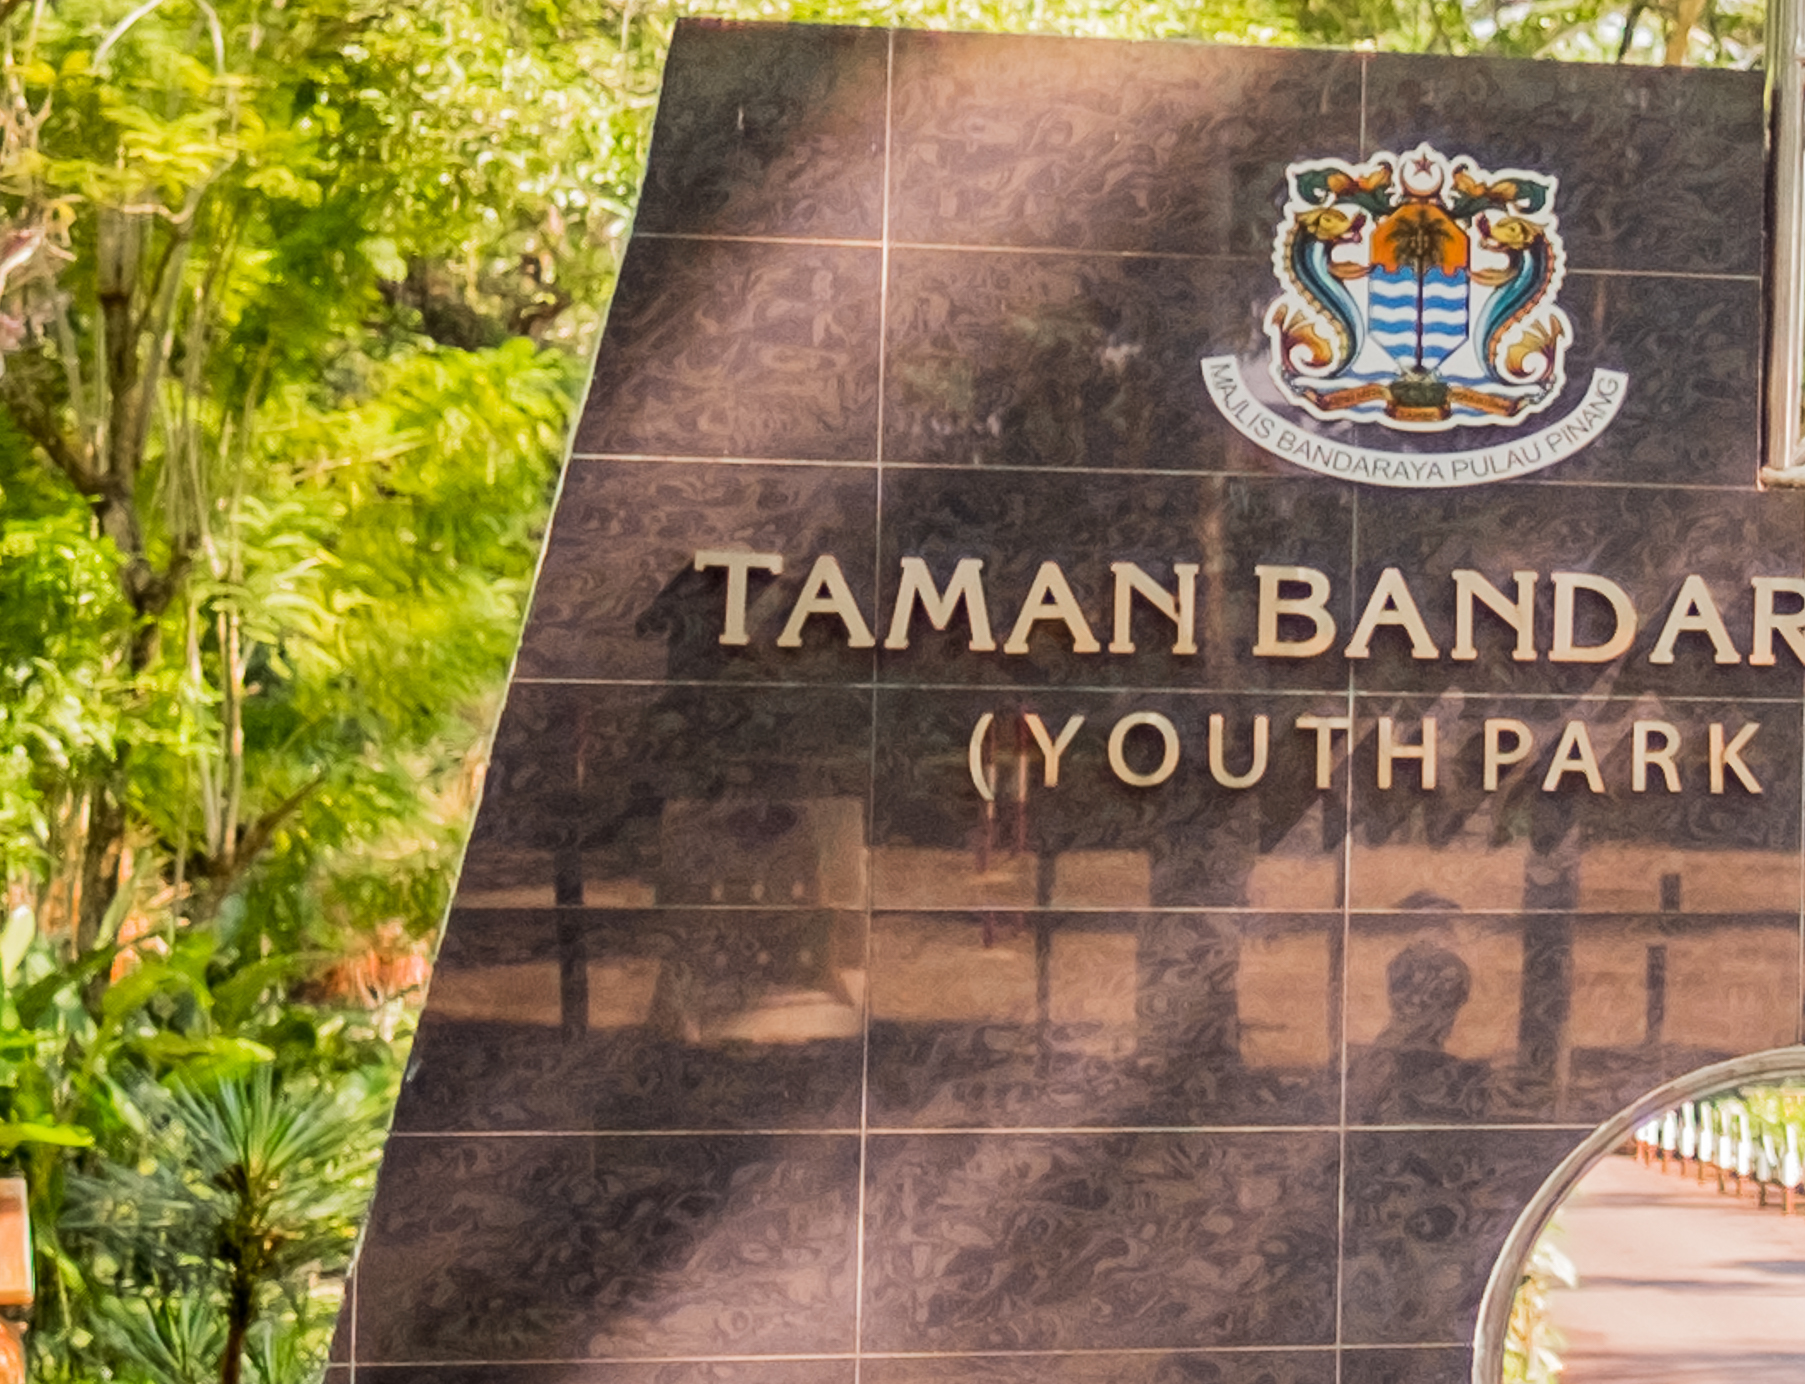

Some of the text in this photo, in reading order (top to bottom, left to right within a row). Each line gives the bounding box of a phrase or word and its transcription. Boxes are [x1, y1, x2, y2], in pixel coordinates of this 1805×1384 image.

[1210, 363, 1620, 482] MAJLIS BANDARAYA PULAU PINANG
[694, 551, 1200, 655] TAMAN
[968, 712, 1763, 802] (YOUTH PARK
